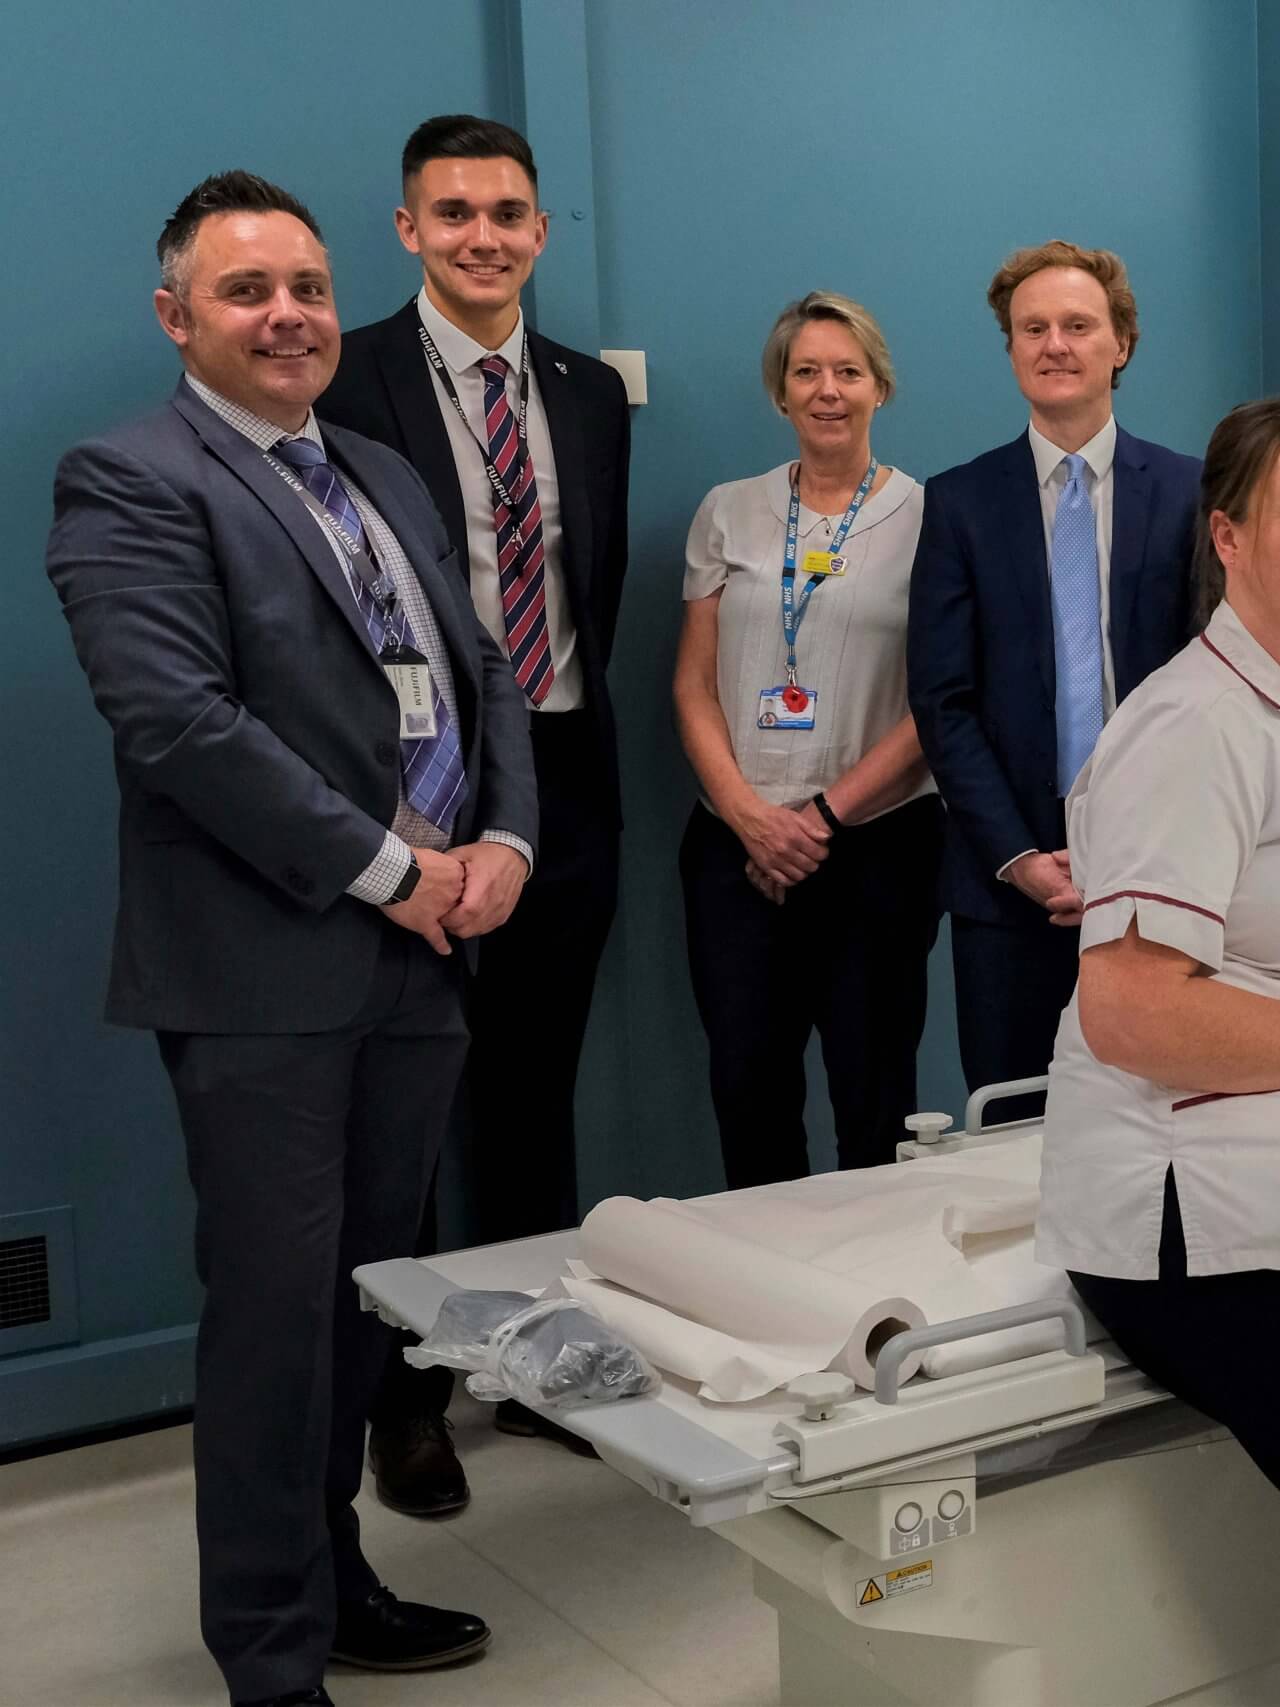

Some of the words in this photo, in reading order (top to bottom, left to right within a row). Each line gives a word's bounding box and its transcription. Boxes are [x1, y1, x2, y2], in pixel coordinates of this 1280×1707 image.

[418, 327, 443, 369] FUJIFILM
[486, 464, 513, 506] FUJIFILM
[852, 490, 865, 507] NHS
[843, 510, 855, 527] NHS
[323, 513, 361, 555] FUJIFILM
[788, 522, 797, 539] NHS
[833, 529, 846, 547] NHS
[786, 543, 796, 560] NHS
[784, 586, 793, 605] NHS
[784, 611, 793, 630] NHS
[408, 667, 423, 706] FUJIFILM
